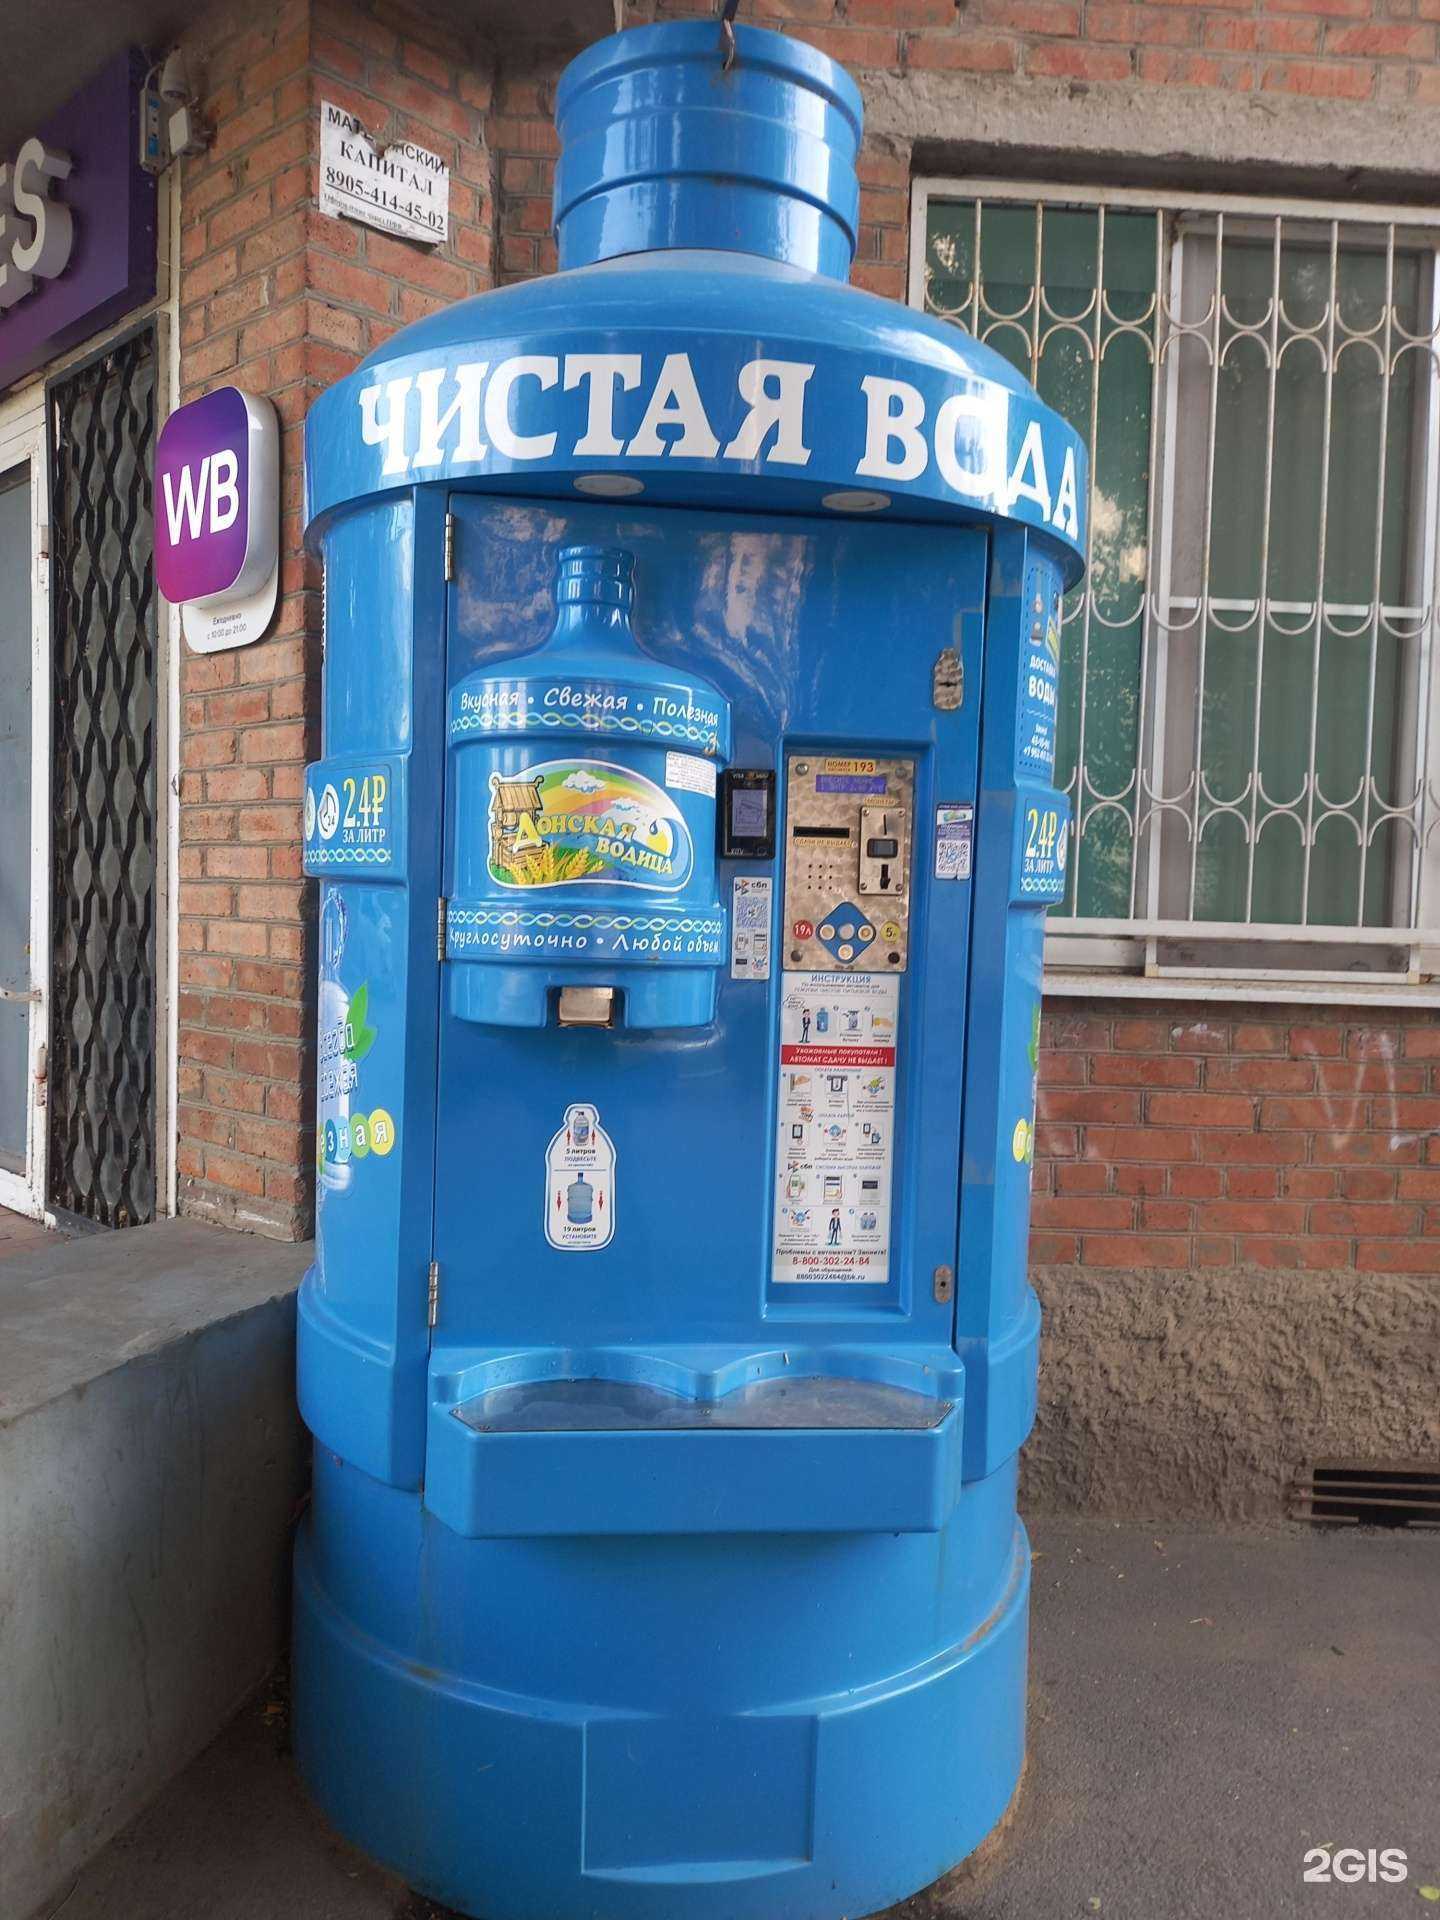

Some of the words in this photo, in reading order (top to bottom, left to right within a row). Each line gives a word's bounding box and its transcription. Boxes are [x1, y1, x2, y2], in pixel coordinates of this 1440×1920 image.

[340, 140, 432, 196] КАПИТАЛ
[326, 166, 445, 231] 8905-414-45-02
[358, 352, 816, 476] ЧИСТАЯ
[855, 375, 1079, 541] ВОДА
[162, 449, 239, 546] WB
[461, 691, 520, 714] Вкусная
[543, 685, 628, 712] Свежая
[653, 696, 720, 728] Полезная
[854, 761, 874, 773] 193
[342, 828, 355, 844] ЗА
[356, 827, 387, 844] ЛИТР
[794, 924, 812, 935] 19л
[450, 927, 588, 951] Круглосуточно
[612, 932, 682, 953] Любой
[812, 974, 872, 984] ИНСТРУКЦИЯ
[789, 1055, 822, 1064] АВТОМАТ
[776, 1248, 811, 1256] Проблемы
[792, 1256, 870, 1265] 8-800-302-24-84
